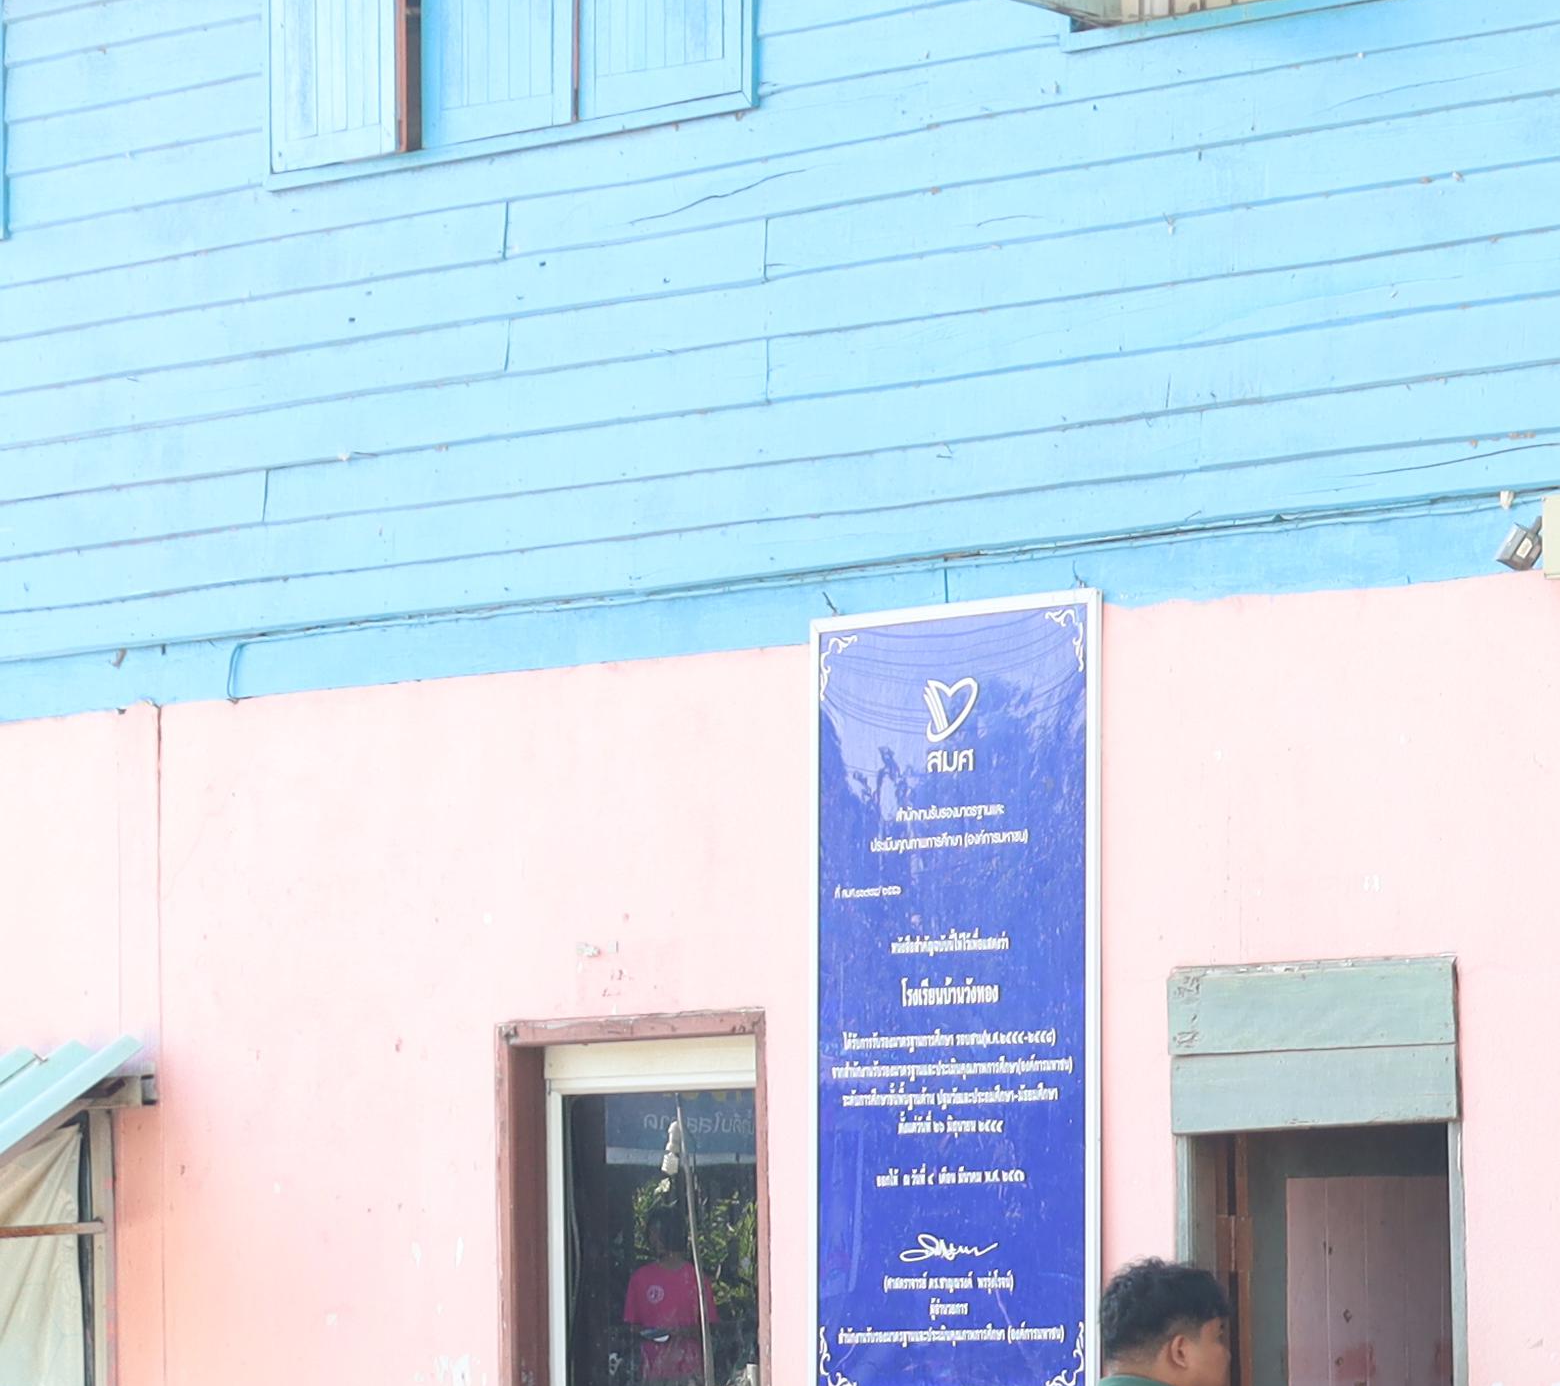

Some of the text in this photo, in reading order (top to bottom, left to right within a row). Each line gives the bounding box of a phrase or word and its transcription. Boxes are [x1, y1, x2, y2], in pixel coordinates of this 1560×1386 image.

[926, 748, 975, 774] สมศ
[901, 977, 999, 1007] โรงเรียนบ้านวังทอง
